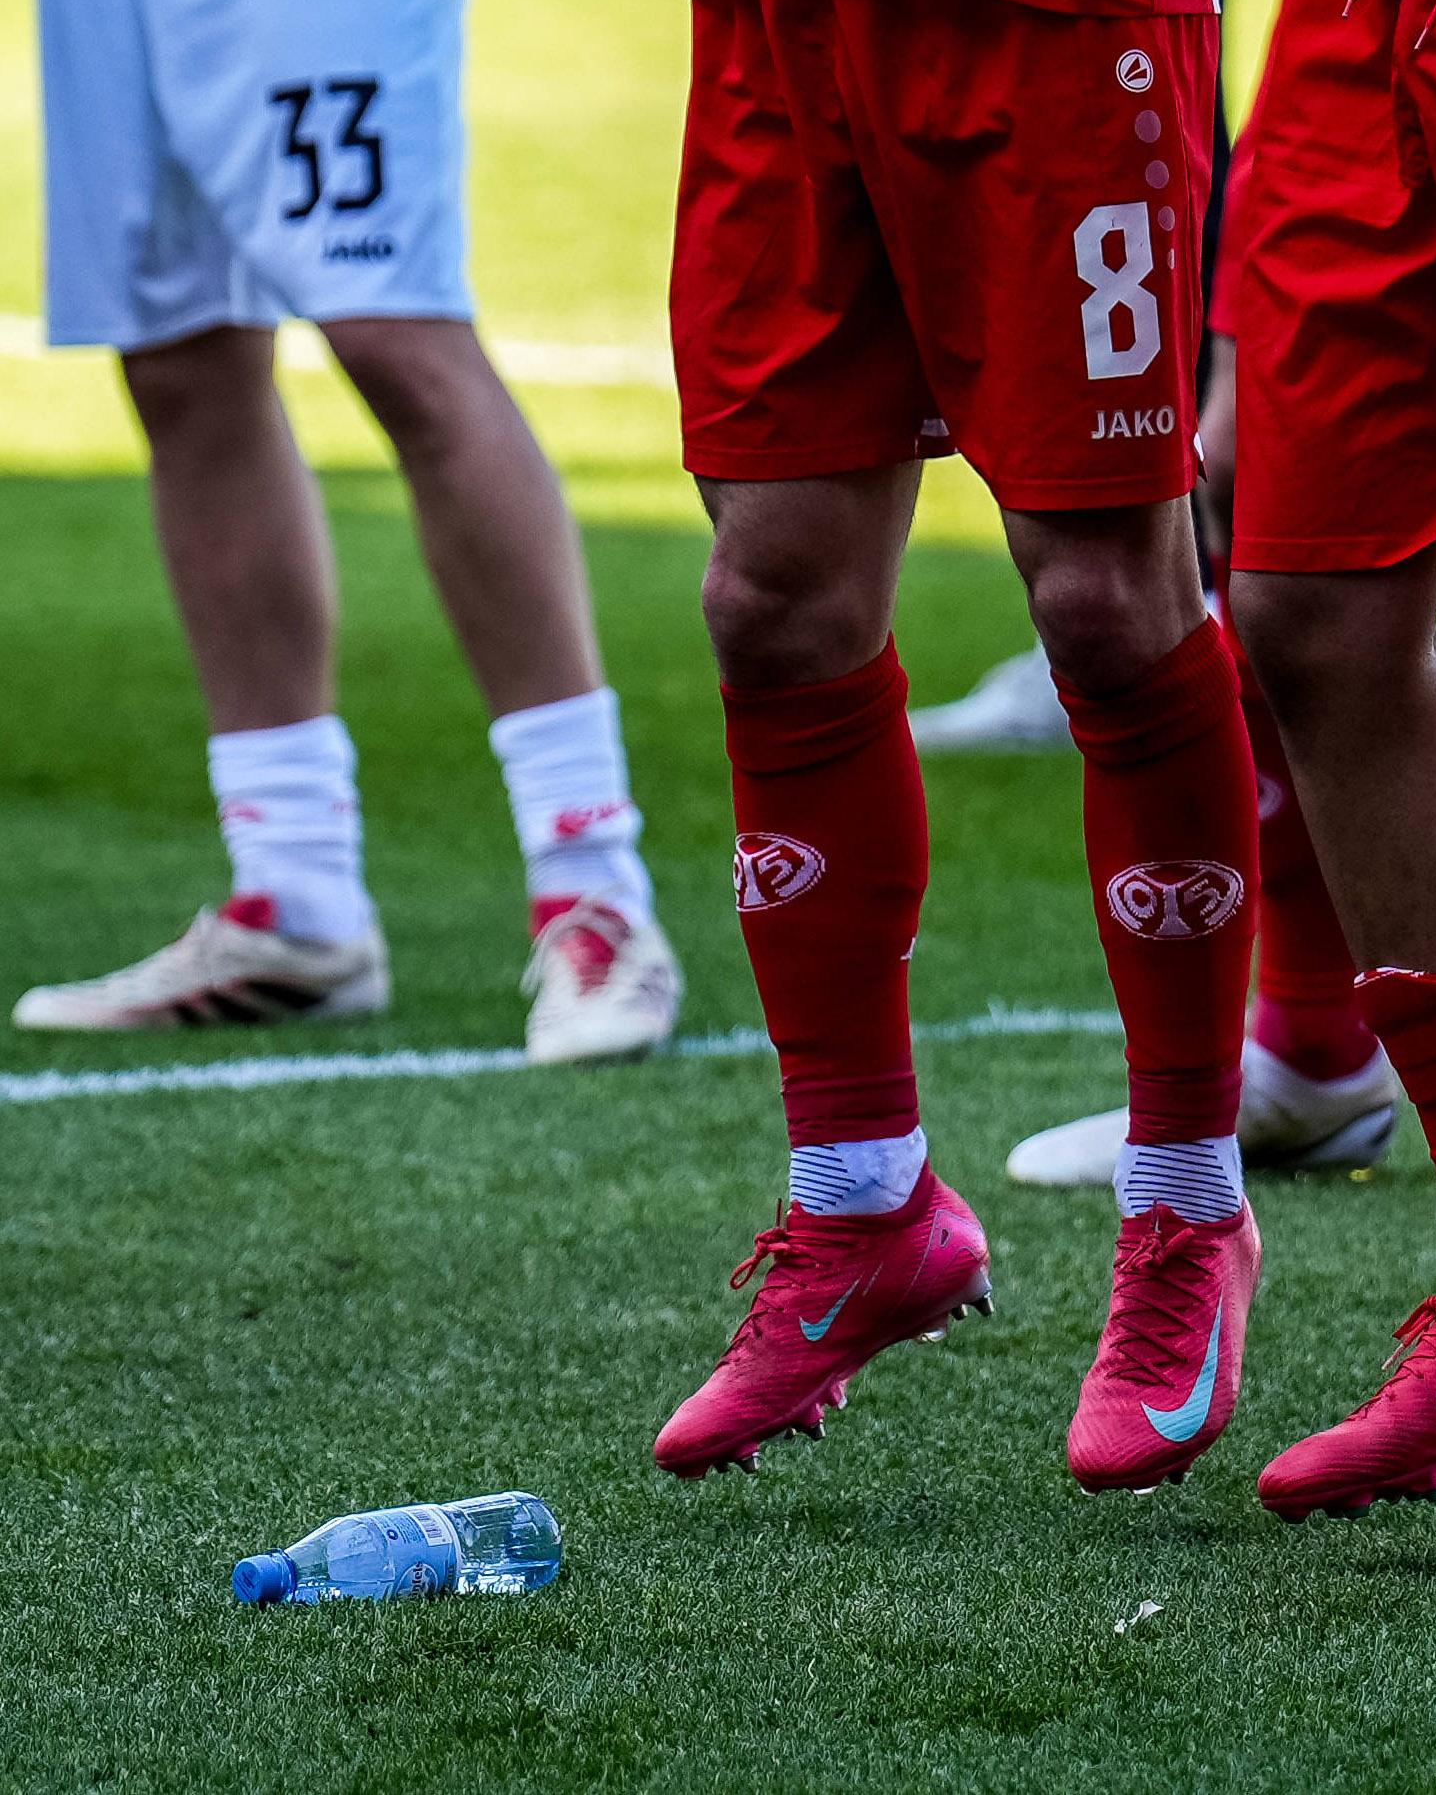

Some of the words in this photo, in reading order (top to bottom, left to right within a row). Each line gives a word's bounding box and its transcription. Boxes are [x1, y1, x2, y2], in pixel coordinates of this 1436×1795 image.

[270, 80, 383, 221] 33
[1074, 201, 1161, 380] 8
[1090, 405, 1176, 440] JAKO
